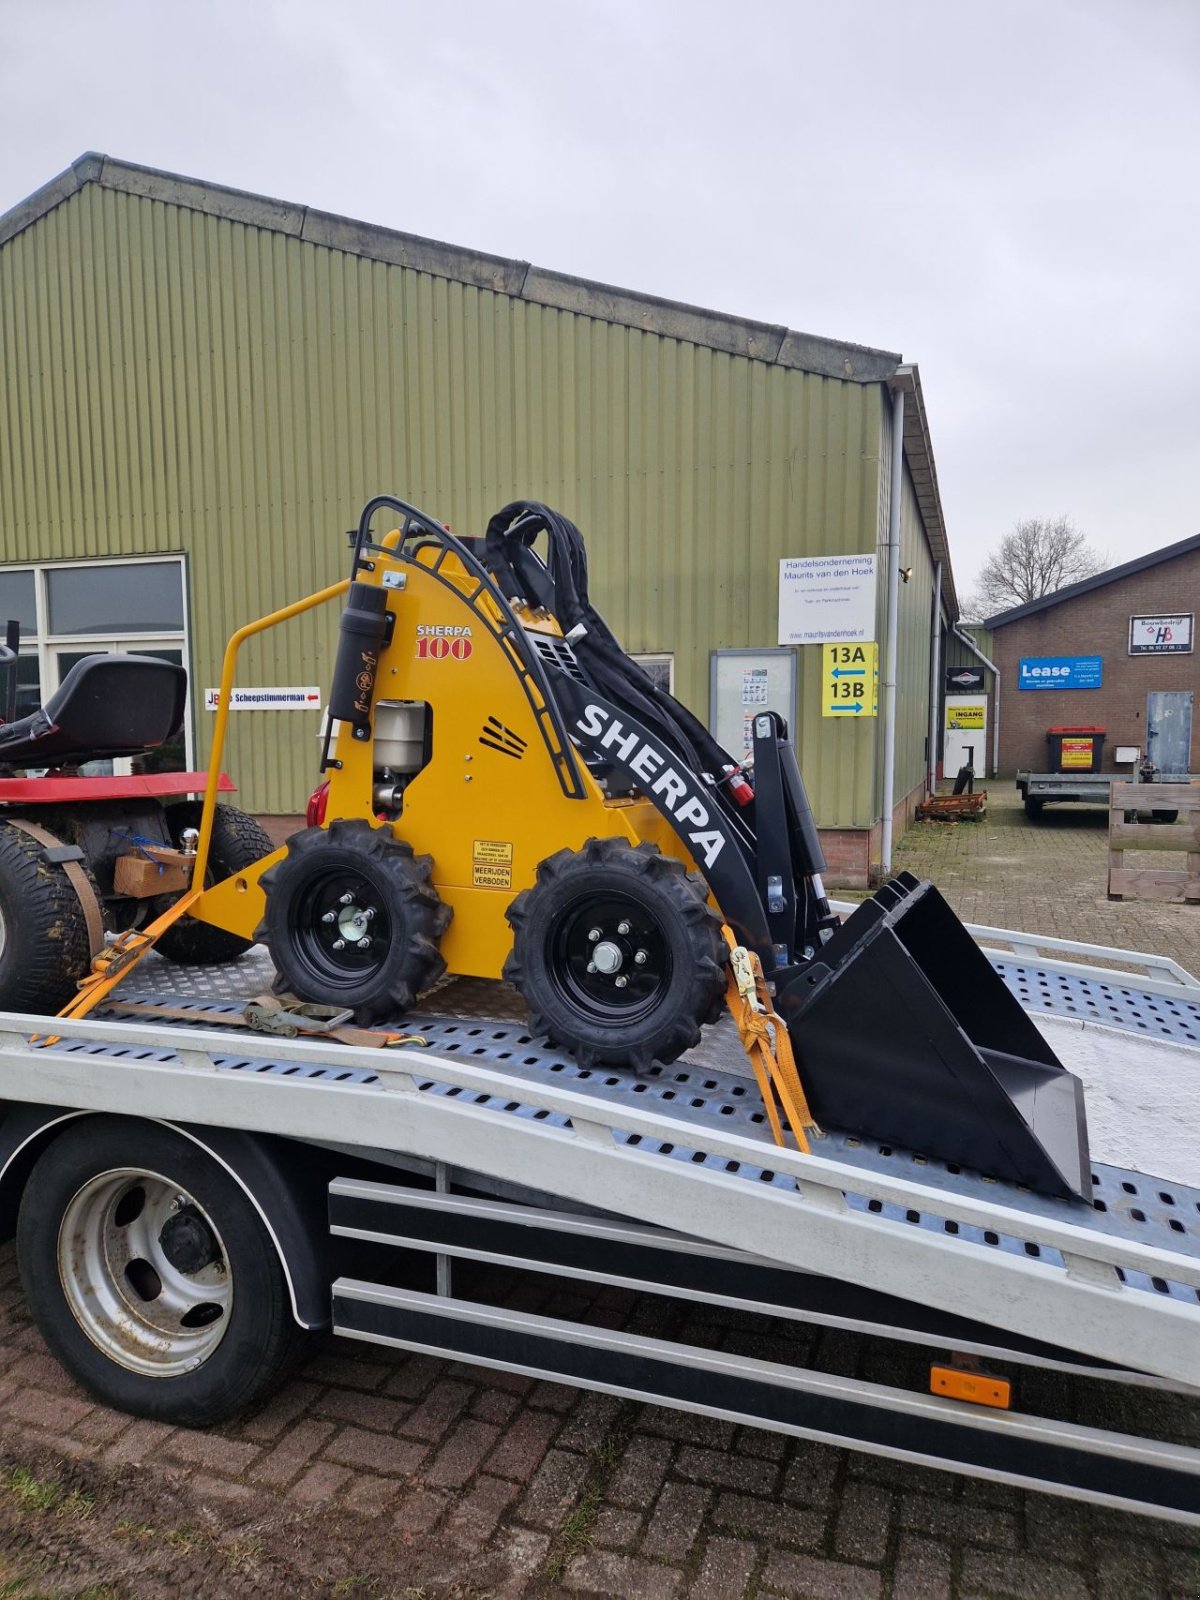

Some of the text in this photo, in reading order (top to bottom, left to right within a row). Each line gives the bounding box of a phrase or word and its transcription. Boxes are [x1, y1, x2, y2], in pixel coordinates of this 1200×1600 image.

[786, 557, 872, 568] Handelsonderneming
[852, 567, 874, 576] Hoek
[416, 624, 472, 636] SHERPA
[415, 636, 472, 660] 100
[830, 646, 866, 663] 13A
[1022, 664, 1071, 677] Lease
[830, 682, 864, 698] 13B
[235, 693, 305, 702] Scheepstimmerman
[576, 704, 726, 869] SHERPA
[475, 867, 509, 876] MEERIJDEN
[475, 876, 509, 886] VERBODEN
